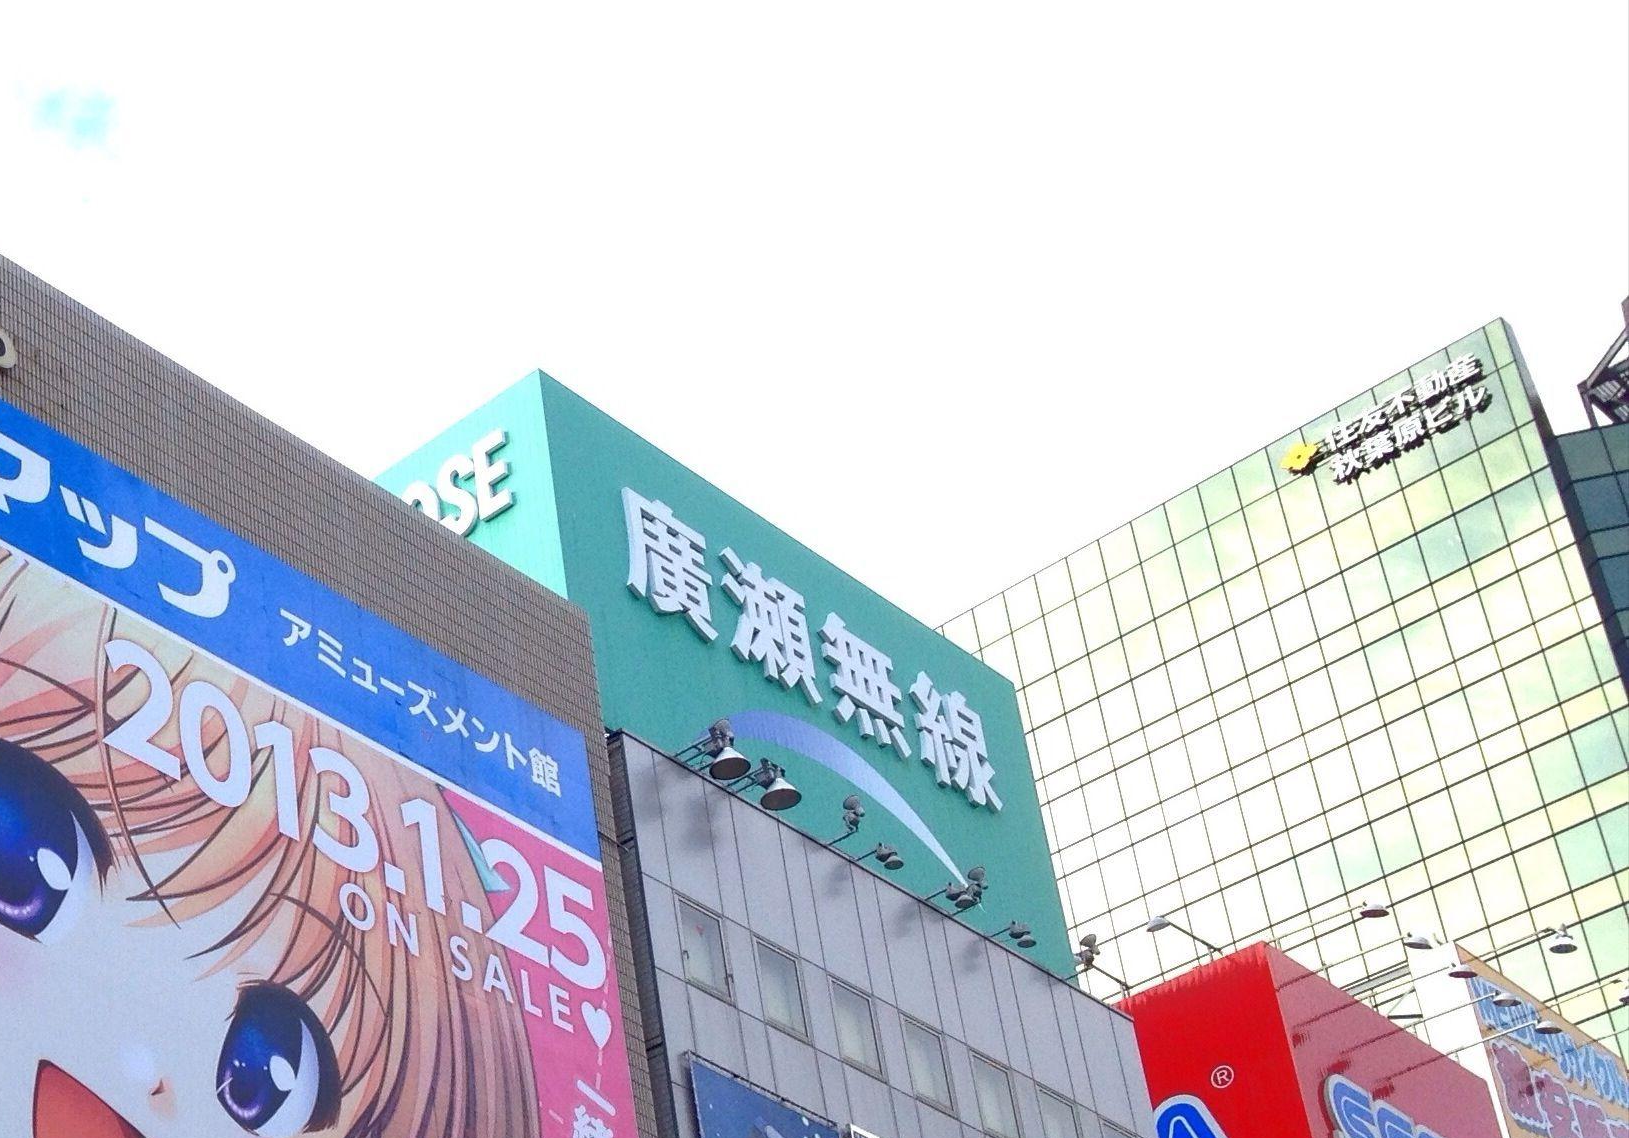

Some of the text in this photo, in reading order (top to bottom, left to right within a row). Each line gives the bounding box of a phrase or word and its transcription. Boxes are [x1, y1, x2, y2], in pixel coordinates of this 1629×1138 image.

[1321, 352, 1483, 451] 住友不動産
[1330, 384, 1488, 482] 秋葉原ビル
[278, 607, 563, 798] アミューズメント館
[622, 487, 1005, 812] 廣瀬無線
[103, 639, 607, 992] 2013.1.25
[337, 881, 420, 959] ON
